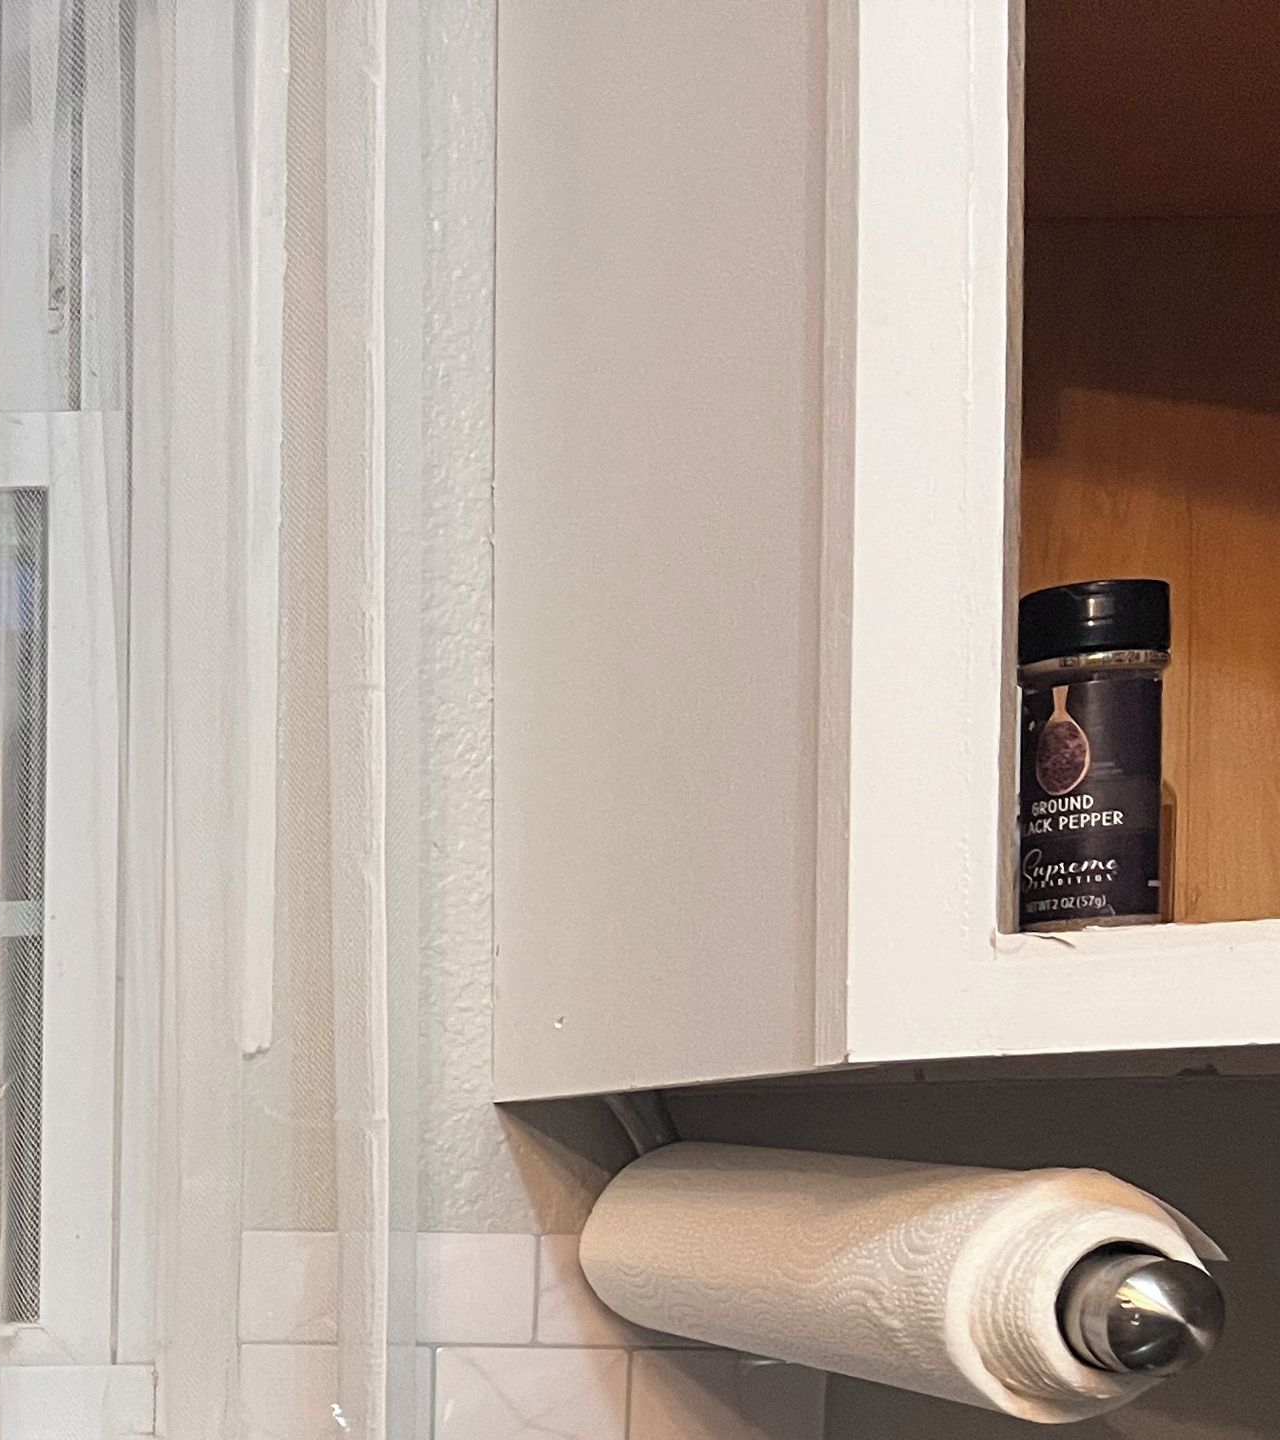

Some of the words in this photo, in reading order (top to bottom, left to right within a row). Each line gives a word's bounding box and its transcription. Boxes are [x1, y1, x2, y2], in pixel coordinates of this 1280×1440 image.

[1032, 795, 1094, 816] GROUND
[1026, 818, 1052, 835] ACK
[1058, 810, 1124, 831] PEPPER
[1023, 849, 1118, 891] Supreme
[1051, 898, 1059, 910] 2
[1060, 896, 1076, 909] OZ
[1076, 894, 1107, 910] (57g)
